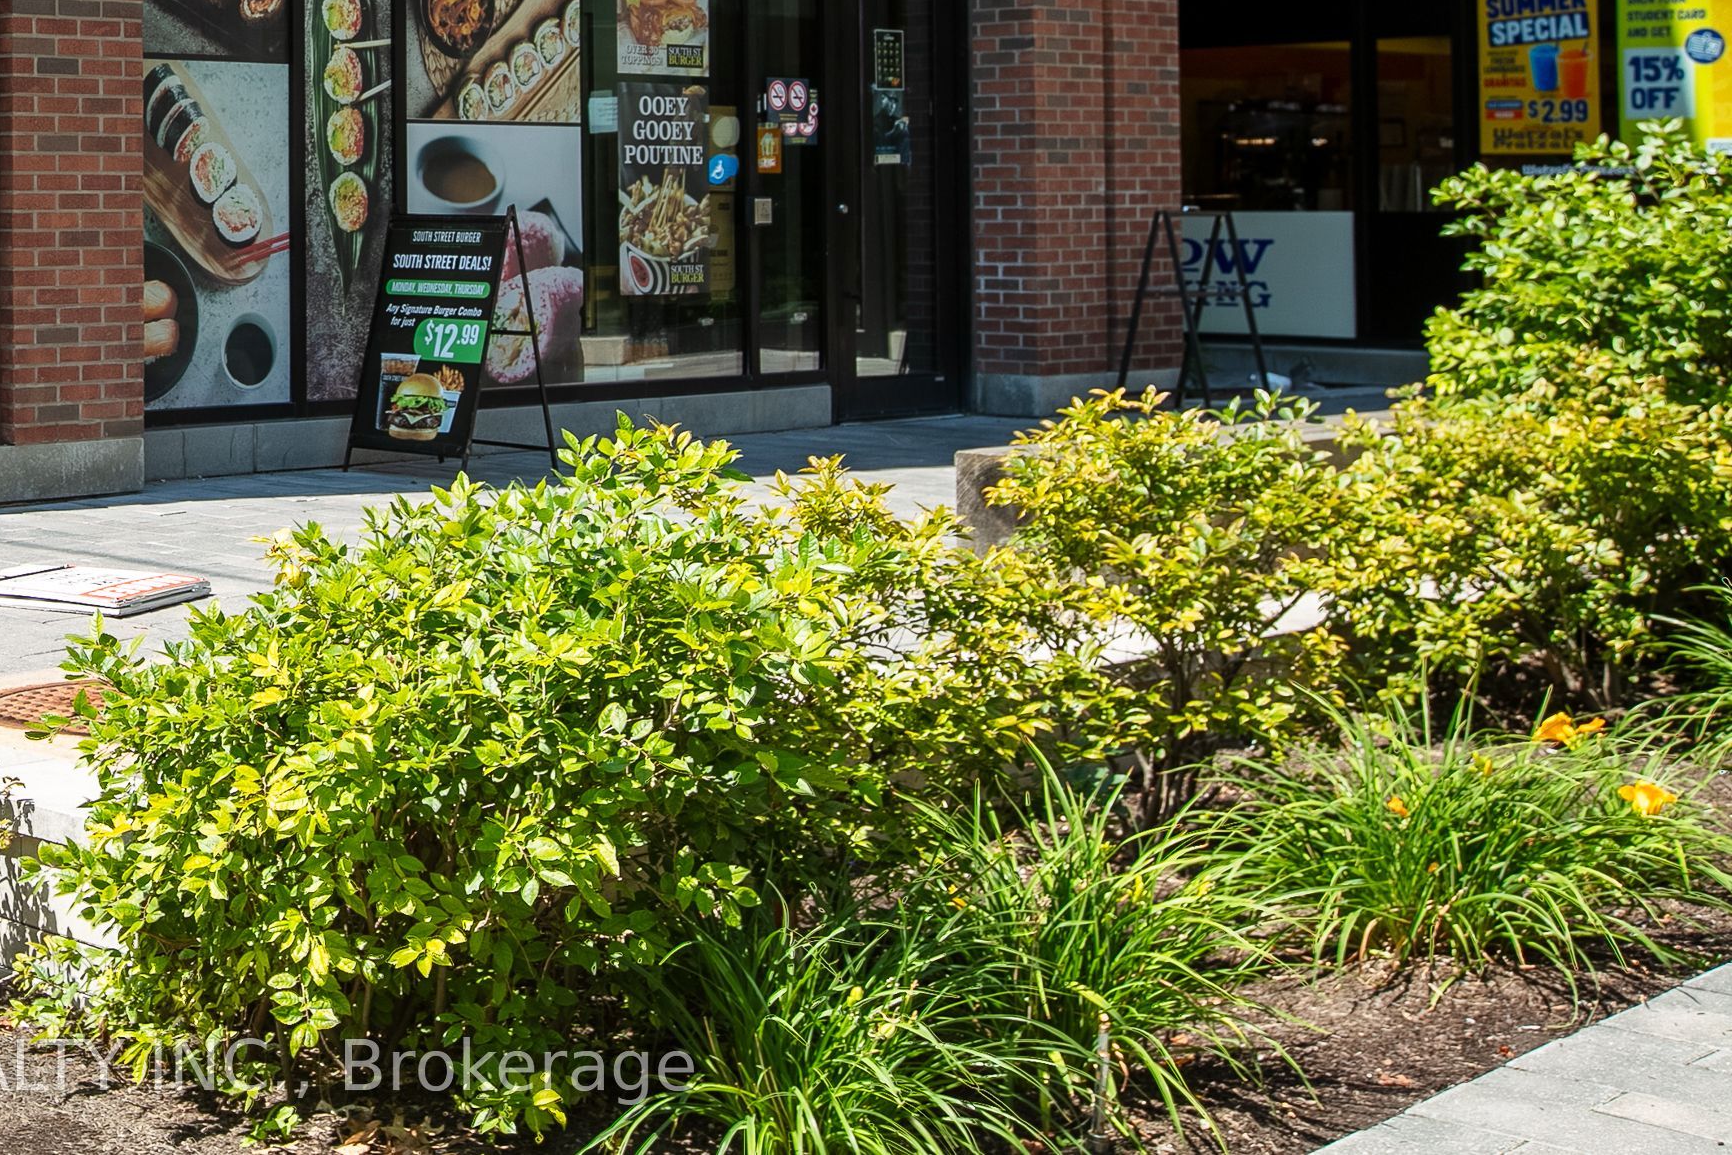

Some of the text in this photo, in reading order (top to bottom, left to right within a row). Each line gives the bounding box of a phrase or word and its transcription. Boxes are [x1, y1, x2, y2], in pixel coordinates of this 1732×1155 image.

[1677, 8, 1706, 21] CARD
[1490, 13, 1589, 45] SPECIAL
[668, 46, 692, 56] SOUTH
[668, 55, 702, 66] BURGER
[1629, 55, 1685, 82] 15%
[1631, 87, 1680, 109] OFF
[639, 95, 689, 116] OOEY
[633, 120, 695, 141] GOOEY
[624, 144, 703, 165] POUTINE
[413, 230, 481, 243] SOUTH STREET BURGER
[393, 254, 492, 271] SOUTH STREET DEALS!
[670, 264, 694, 273] SOUTH
[671, 273, 704, 283] BURGER
[391, 281, 486, 295] MONDAY, WEDNESDAY, THURSDAY
[386, 303, 483, 317] Any Signature Burger Combo
[390, 316, 416, 328] for just
[424, 320, 480, 358] $12.99
